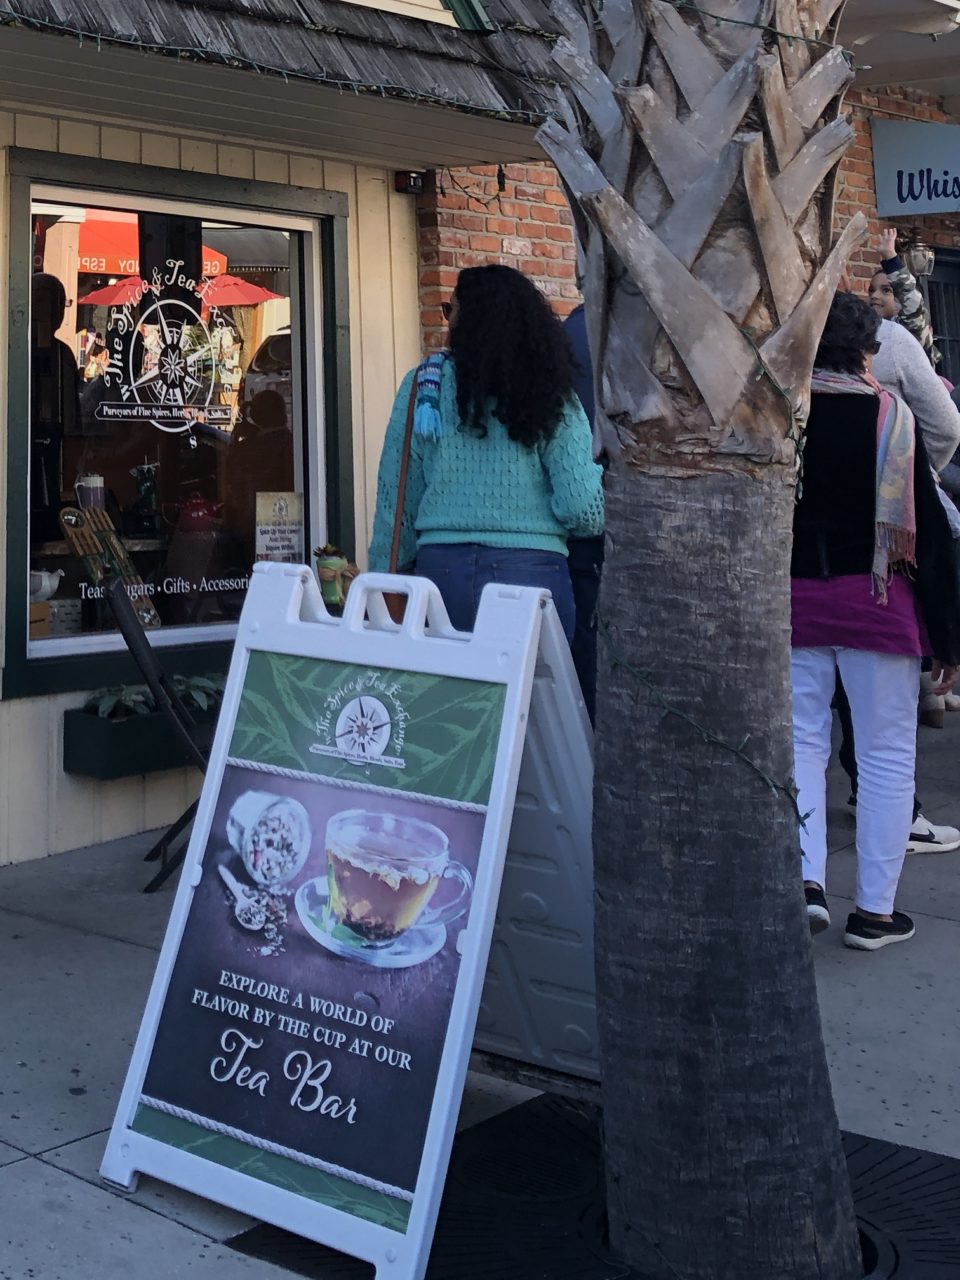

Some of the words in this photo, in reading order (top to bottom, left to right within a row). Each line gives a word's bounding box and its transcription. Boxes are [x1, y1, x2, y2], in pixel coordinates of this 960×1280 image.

[165, 258, 197, 291] Tea
[107, 278, 150, 336] Spice
[104, 337, 124, 388] The
[103, 405, 132, 418] Purveyors
[132, 405, 138, 416] of
[138, 405, 152, 416] Fine
[127, 578, 155, 601] ugars
[163, 577, 190, 595] Gifts
[199, 573, 251, 592] Accessori
[219, 970, 290, 1006] EXPLORE
[292, 992, 304, 1008] A
[309, 996, 368, 1027] WORLD
[370, 1015, 395, 1035] OF
[192, 989, 250, 1019] FLAVOR
[252, 1007, 275, 1027] BY
[278, 1014, 310, 1039] THE
[312, 1026, 347, 1049] CUP
[348, 1038, 373, 1058] AT
[374, 1046, 412, 1071] OUR
[210, 1029, 270, 1097] Tea
[283, 1050, 357, 1125] Bar
